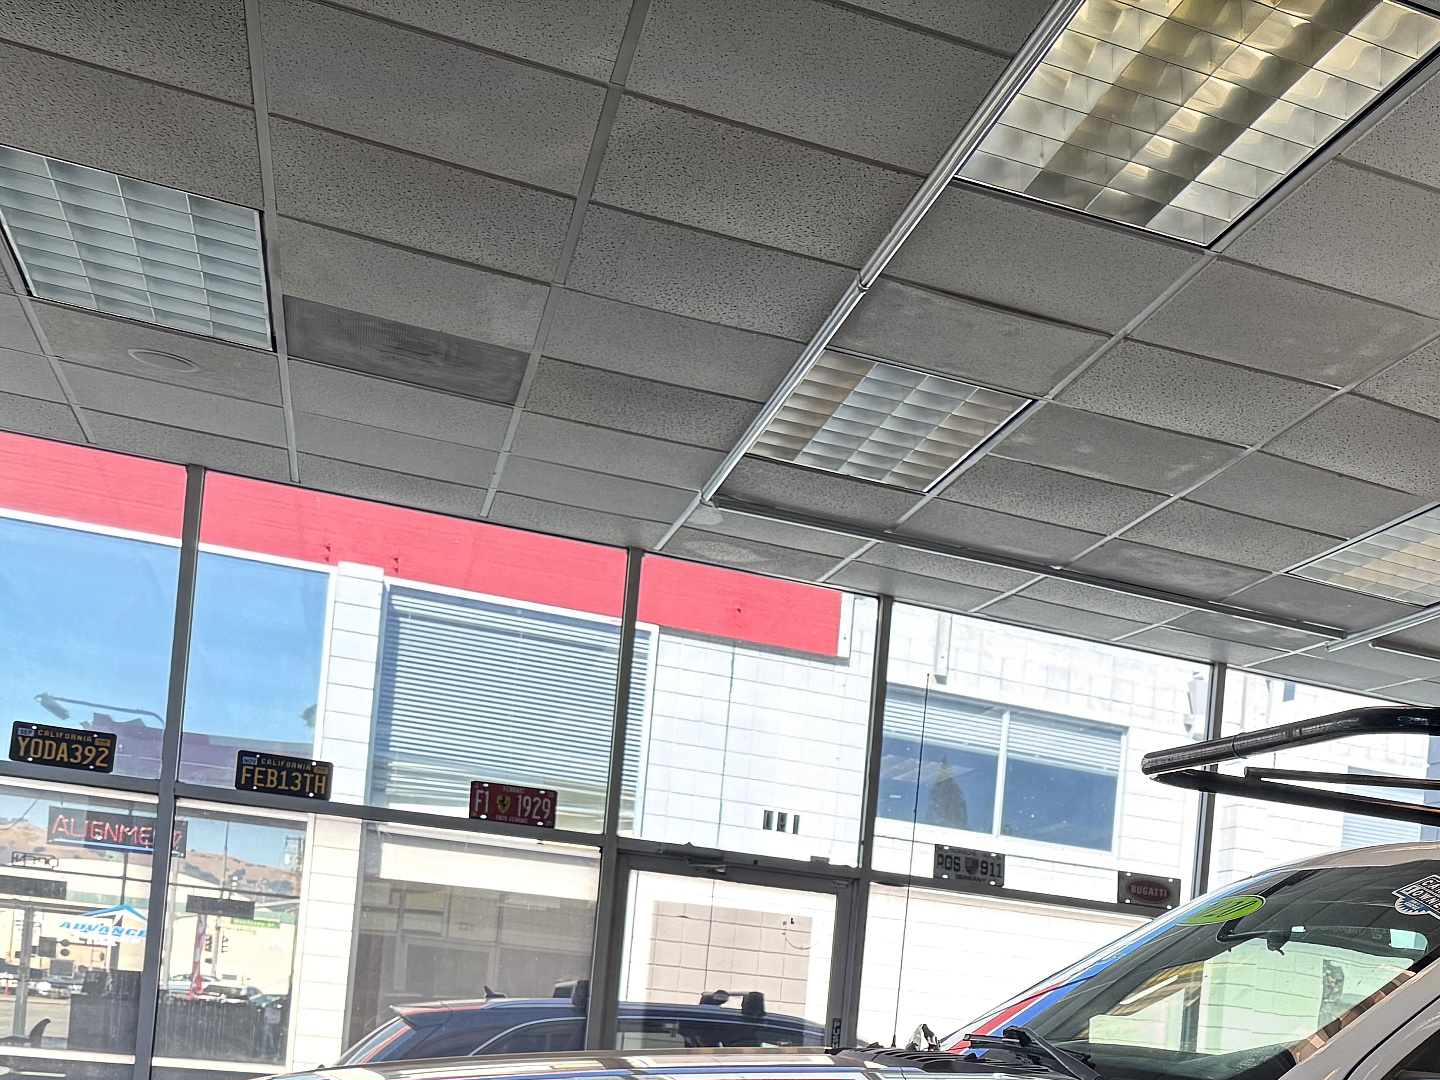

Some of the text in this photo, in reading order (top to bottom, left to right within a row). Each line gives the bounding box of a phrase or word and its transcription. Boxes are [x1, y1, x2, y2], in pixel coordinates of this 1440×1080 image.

[38, 729, 92, 742] CALIFORNIA
[18, 736, 109, 768] YODA392
[261, 758, 311, 771] CALIFORNIA
[241, 766, 327, 795] FEB13TH
[475, 789, 551, 820] F1 1929
[52, 814, 183, 848] ALIGNMET
[981, 860, 1002, 878] 911
[1131, 884, 1168, 898] BUGATTI
